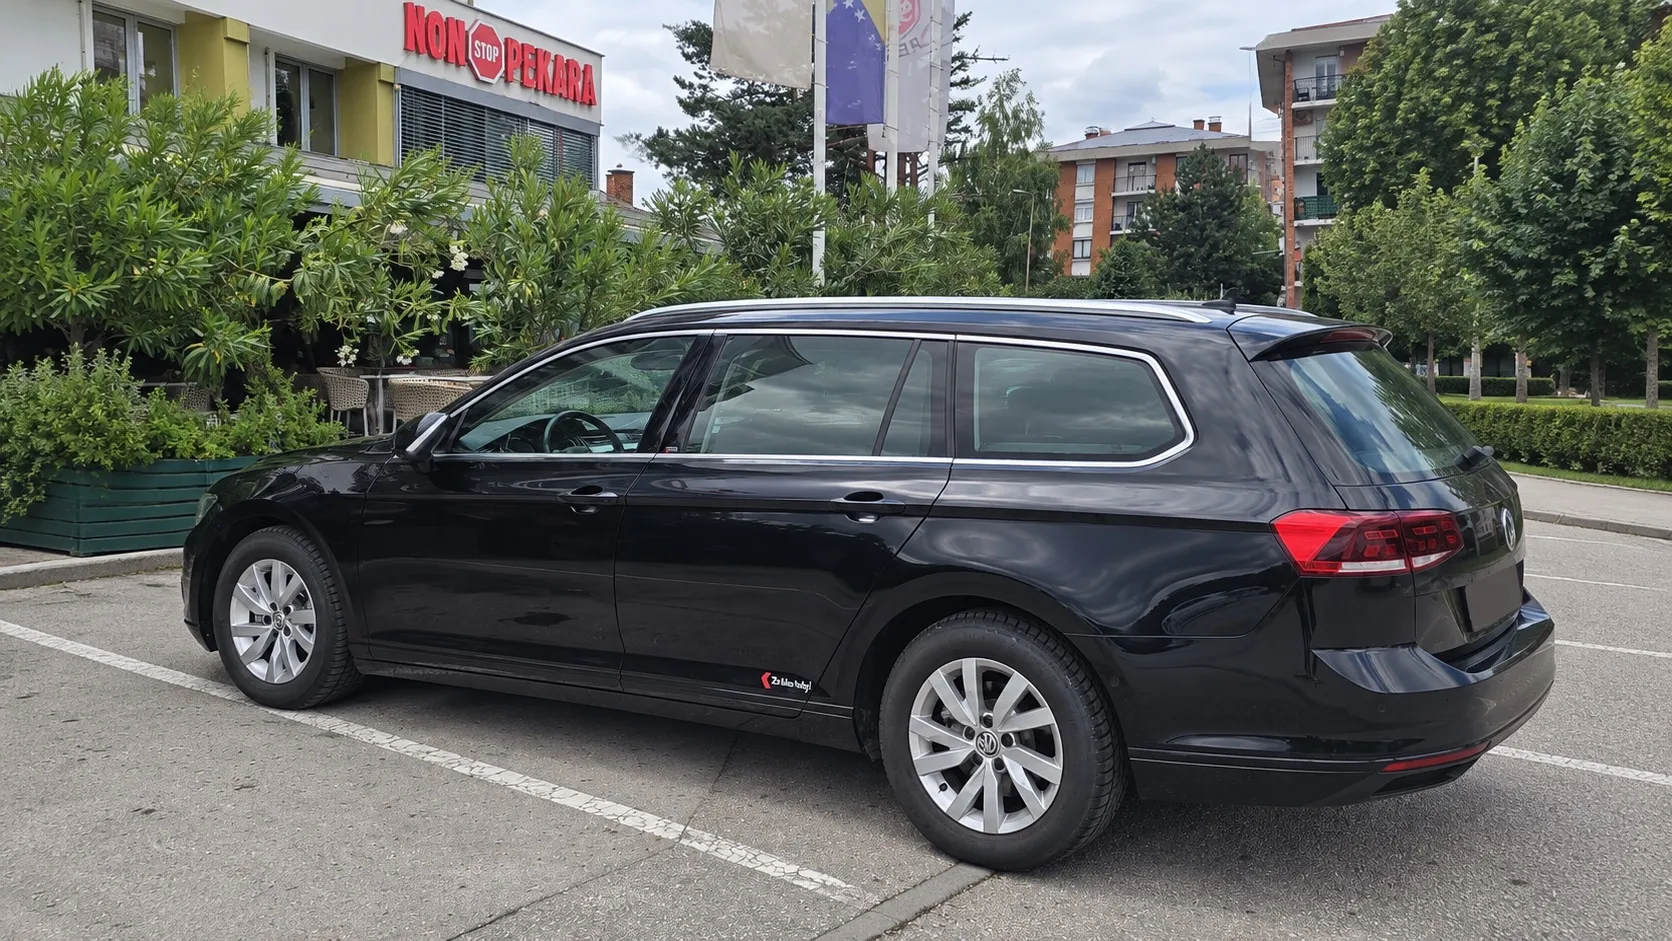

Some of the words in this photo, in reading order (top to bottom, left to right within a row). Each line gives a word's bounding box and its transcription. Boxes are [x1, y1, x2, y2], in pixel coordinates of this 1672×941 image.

[403, 2, 465, 66] NON
[474, 39, 499, 64] STOP
[504, 37, 597, 106] PEKARA
